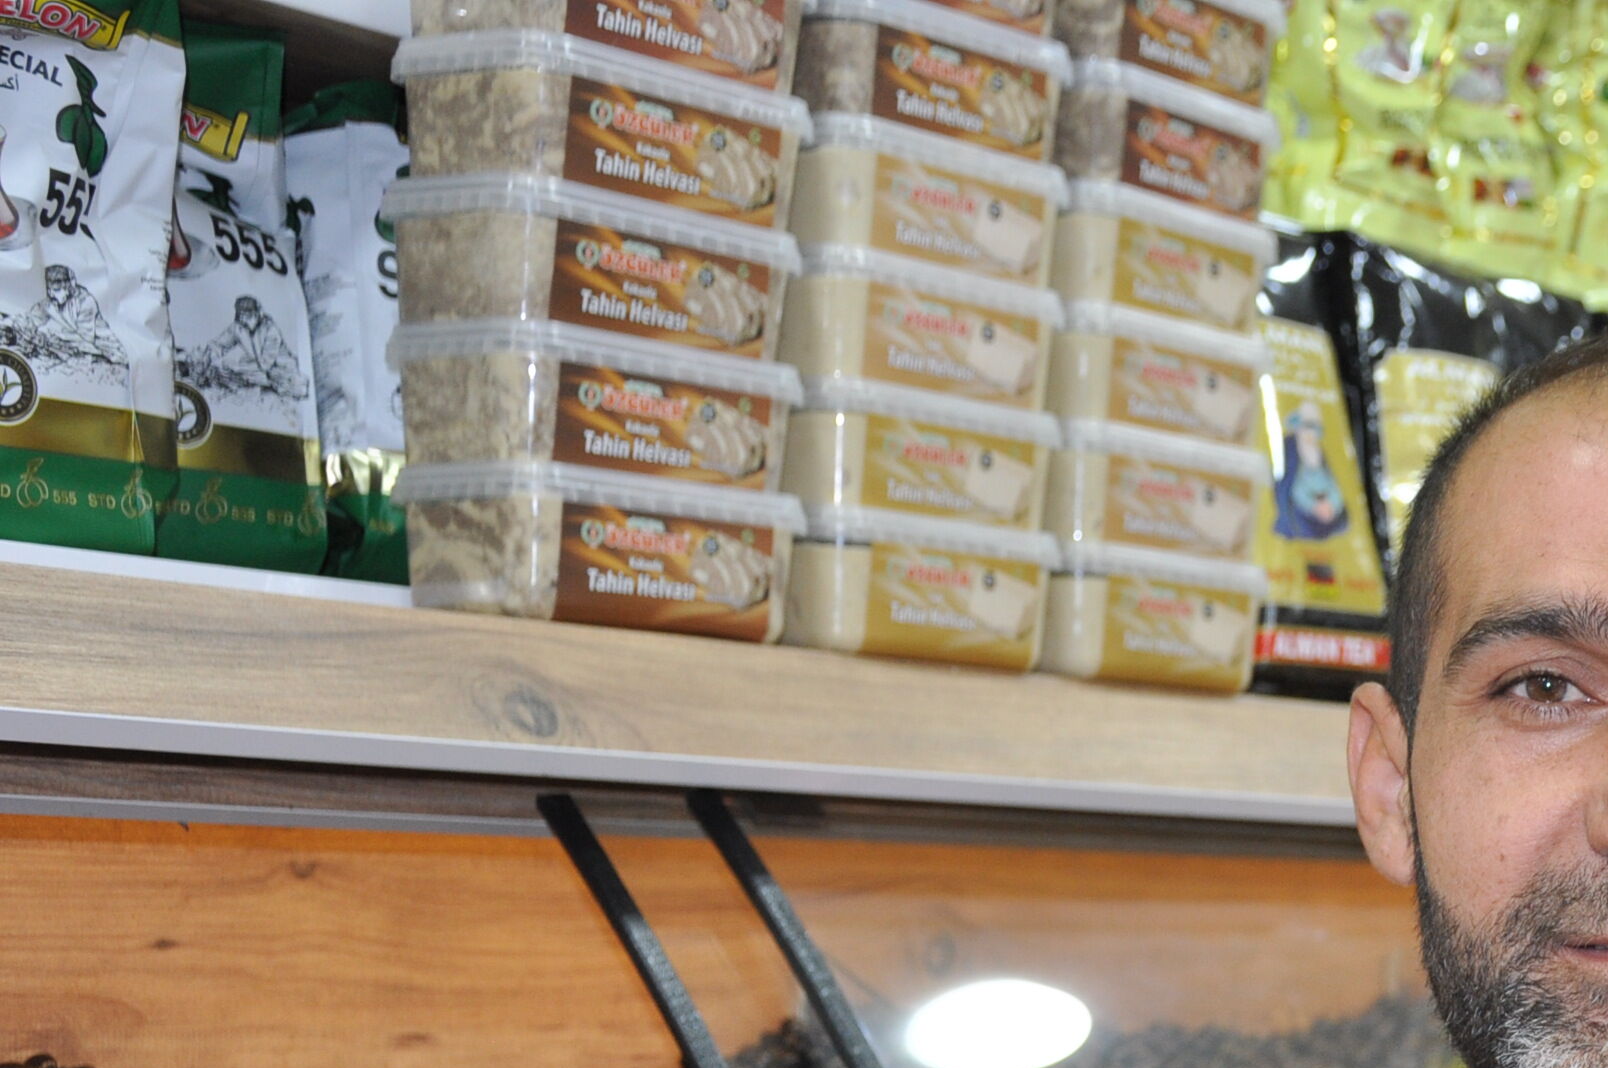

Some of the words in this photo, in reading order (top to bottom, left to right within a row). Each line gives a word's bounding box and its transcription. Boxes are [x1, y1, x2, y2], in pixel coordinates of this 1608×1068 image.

[596, 3, 643, 39] Tahin
[594, 147, 641, 182] Tahin
[211, 214, 289, 276] 555
[580, 287, 627, 321] Tahin
[583, 429, 631, 459] Tahin
[586, 567, 635, 595] Tahin
